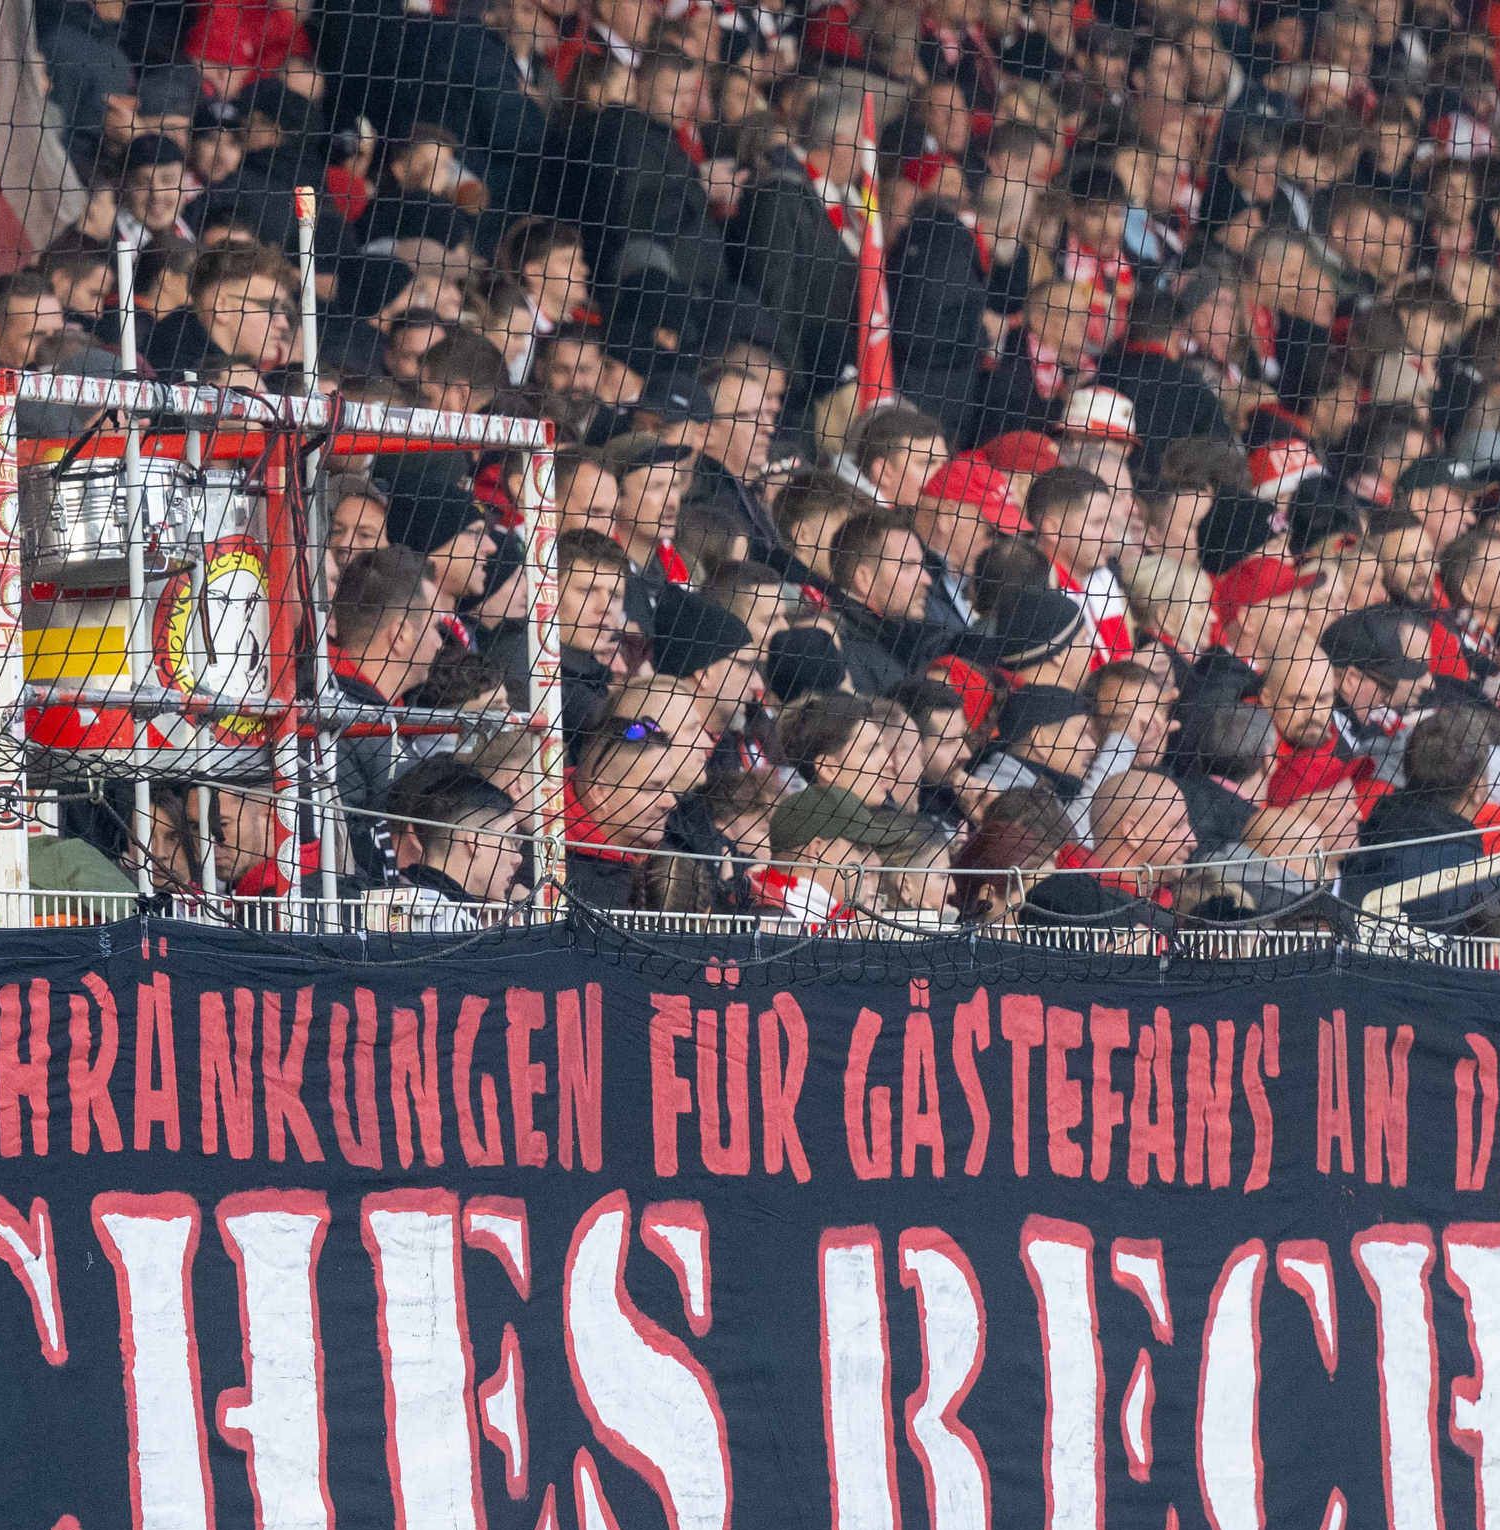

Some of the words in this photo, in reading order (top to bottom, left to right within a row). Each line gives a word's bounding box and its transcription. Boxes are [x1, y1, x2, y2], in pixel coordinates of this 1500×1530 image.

[650, 957, 811, 1184] FÜR
[845, 978, 1279, 1193] GÄSTEFANS
[1317, 1009, 1413, 1189] AN
